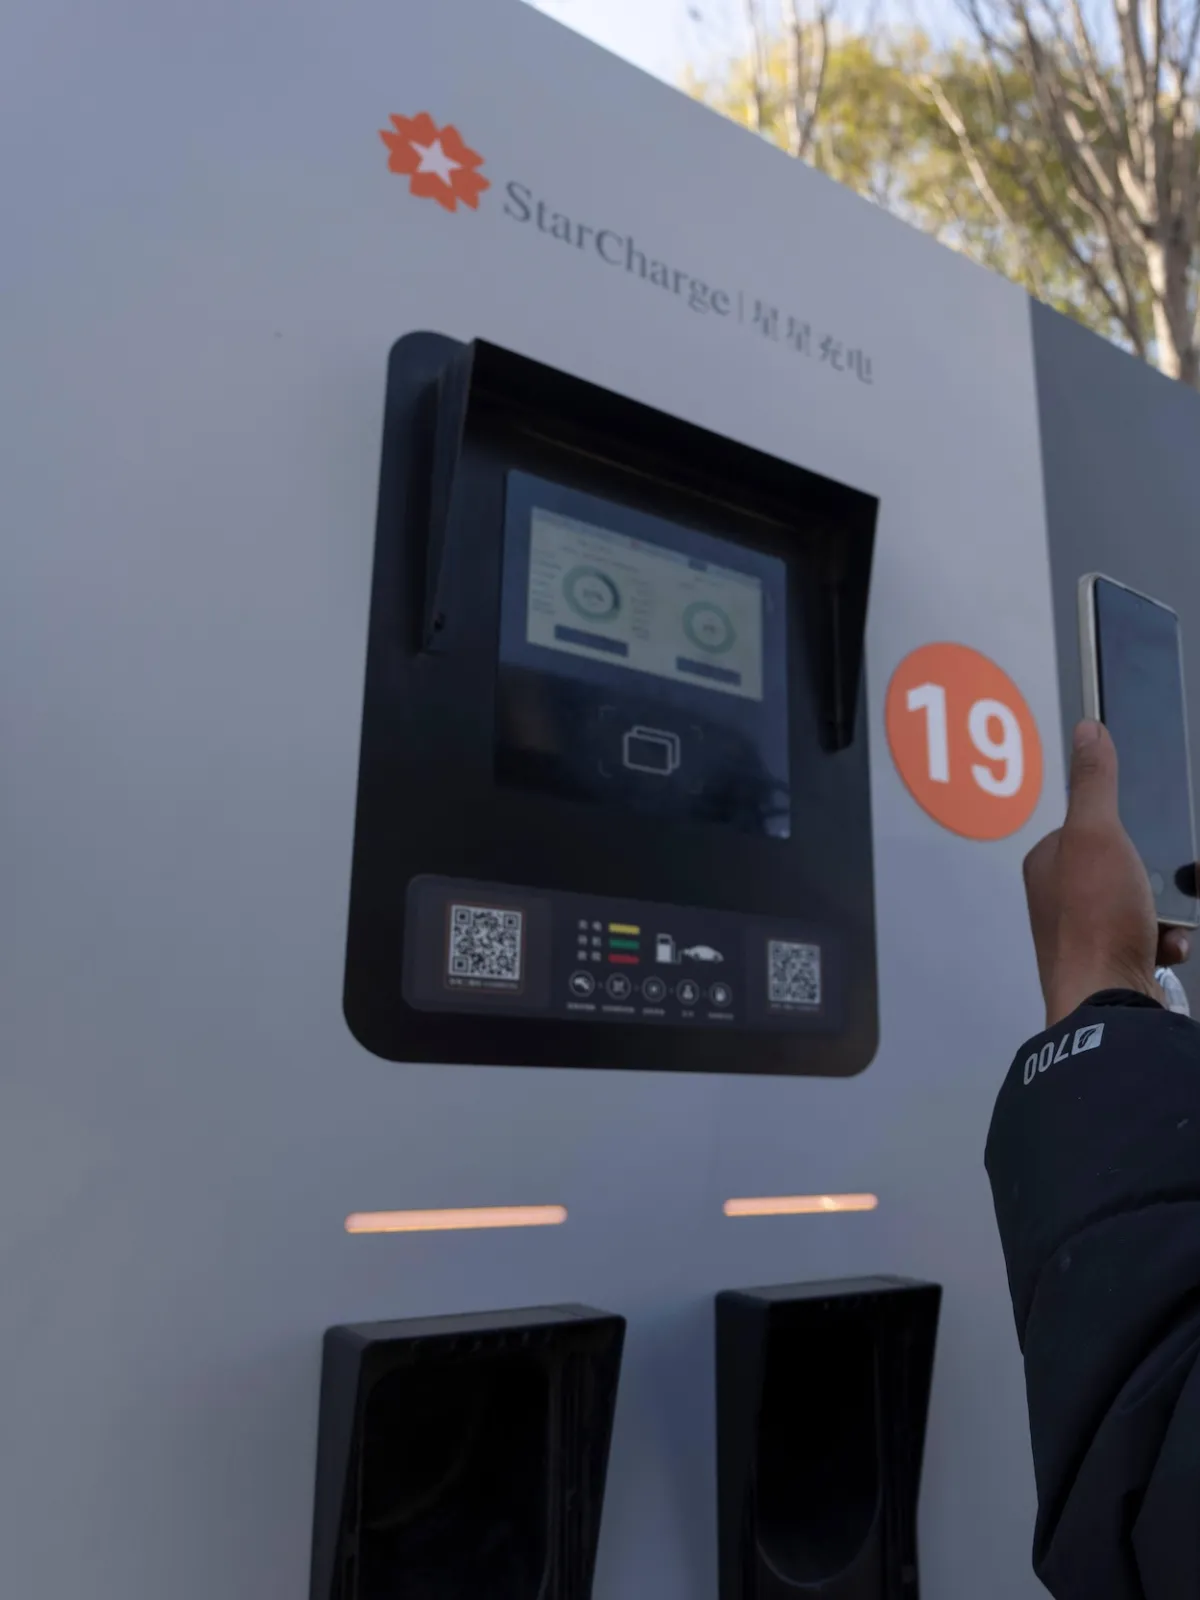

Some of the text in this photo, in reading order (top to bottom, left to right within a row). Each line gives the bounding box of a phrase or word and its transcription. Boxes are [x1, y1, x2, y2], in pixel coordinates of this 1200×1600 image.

[503, 181, 731, 315] StarCharge
[907, 682, 1024, 798] 19
[1023, 1033, 1070, 1085] 700
